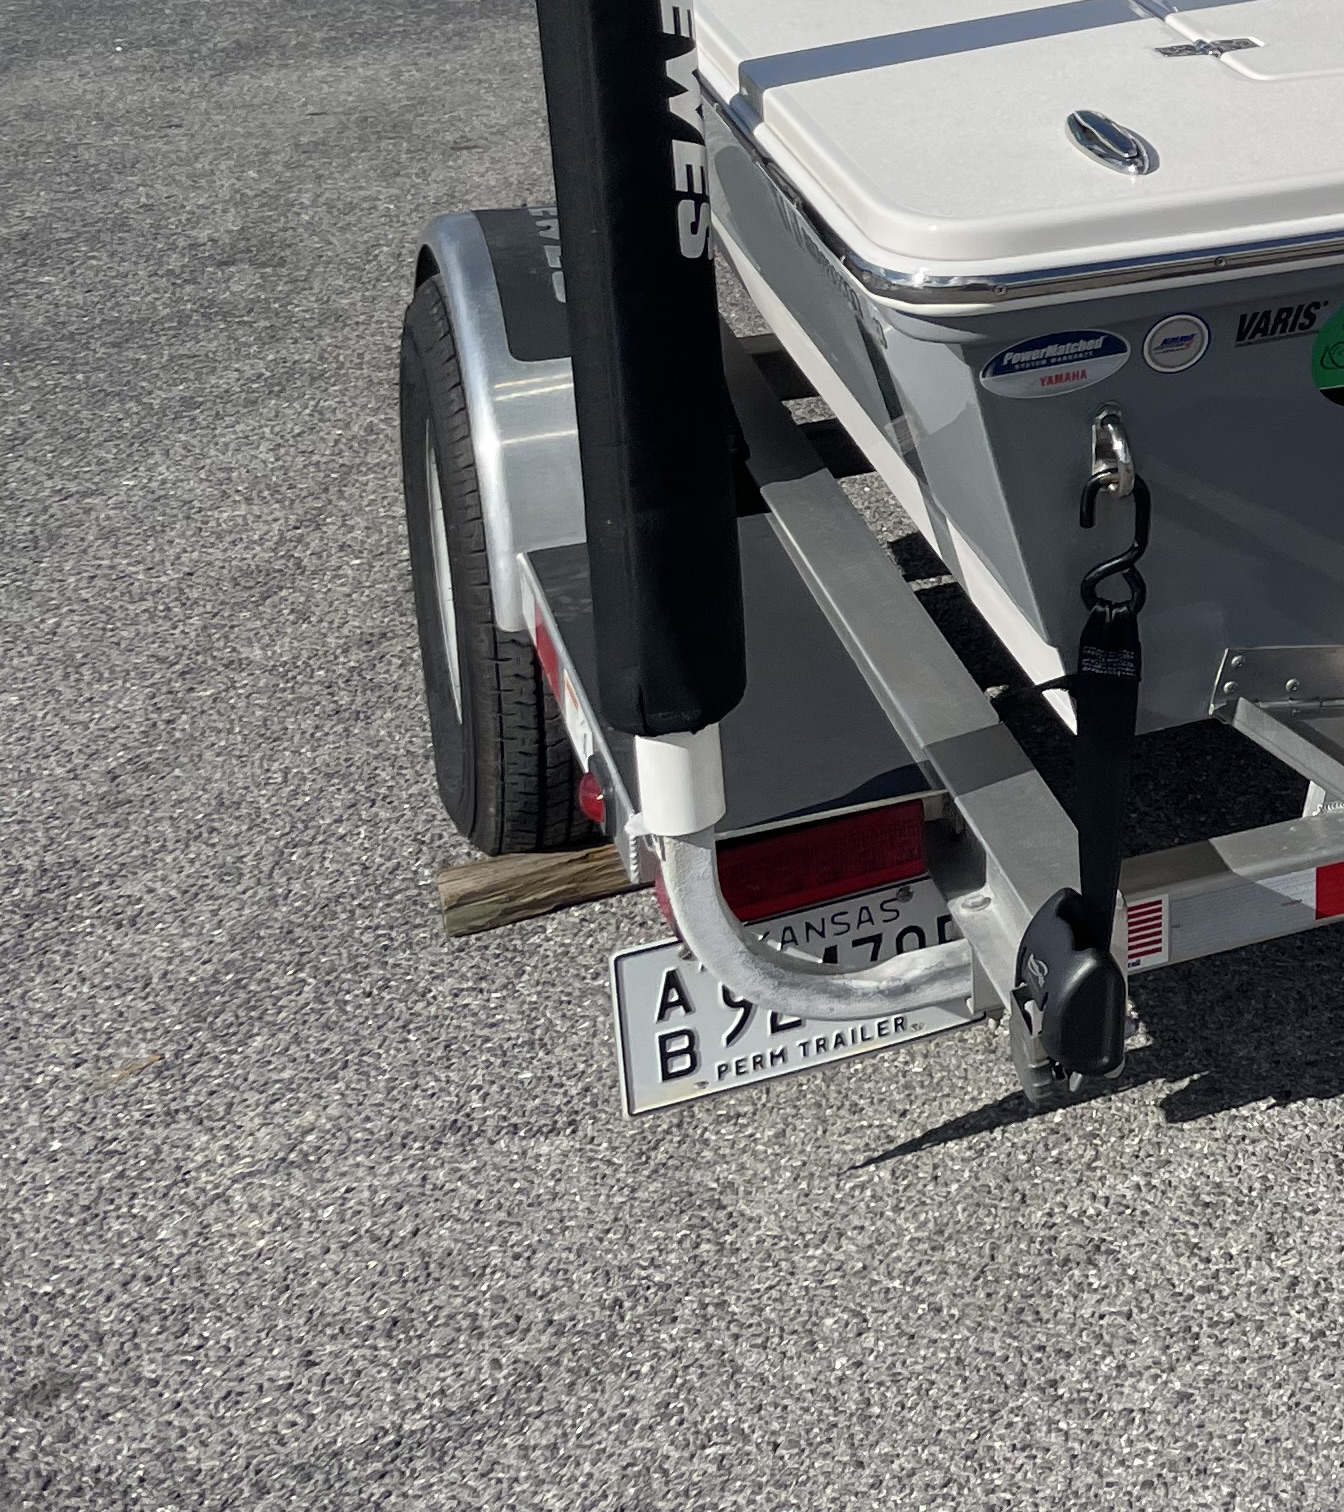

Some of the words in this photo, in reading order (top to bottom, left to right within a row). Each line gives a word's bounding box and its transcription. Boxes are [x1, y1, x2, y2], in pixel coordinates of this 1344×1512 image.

[1235, 301, 1321, 343] VARIS
[1039, 369, 1088, 387] YAMAHA
[716, 1046, 787, 1081] PERM
[798, 1016, 907, 1059] TRAILER
